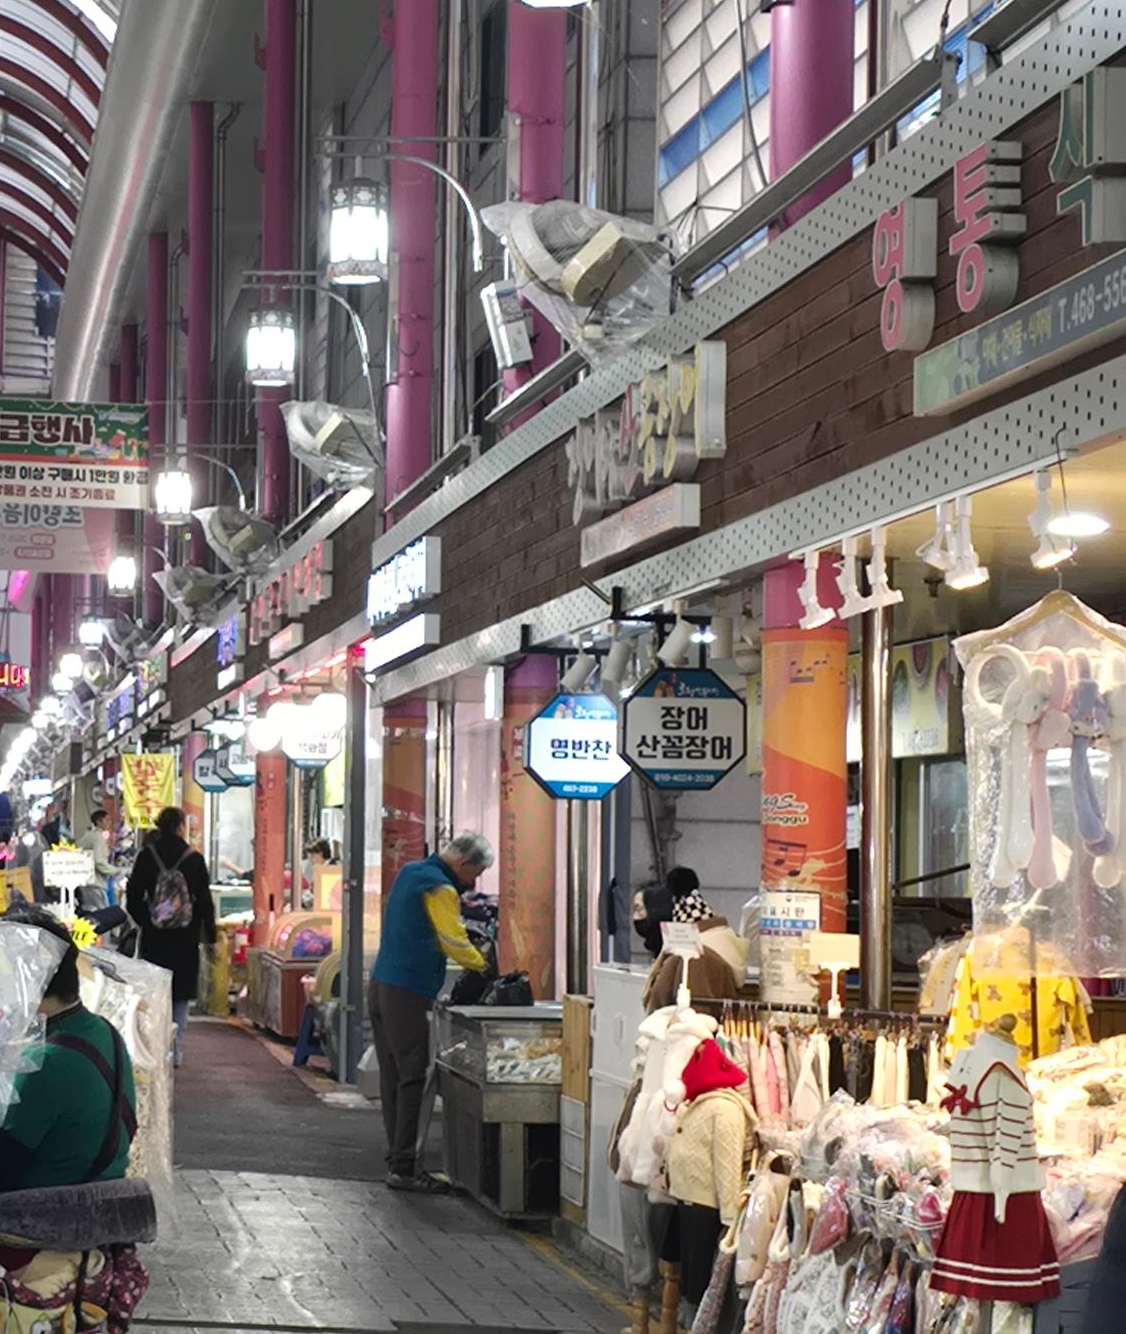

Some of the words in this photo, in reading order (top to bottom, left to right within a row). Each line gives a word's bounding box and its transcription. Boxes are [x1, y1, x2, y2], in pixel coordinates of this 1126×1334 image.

[19, 465, 45, 481] 이상
[89, 469, 120, 484] 1만원
[55, 489, 67, 499] 시
[660, 706, 708, 731] 장어
[636, 734, 732, 760] 산꼼장어
